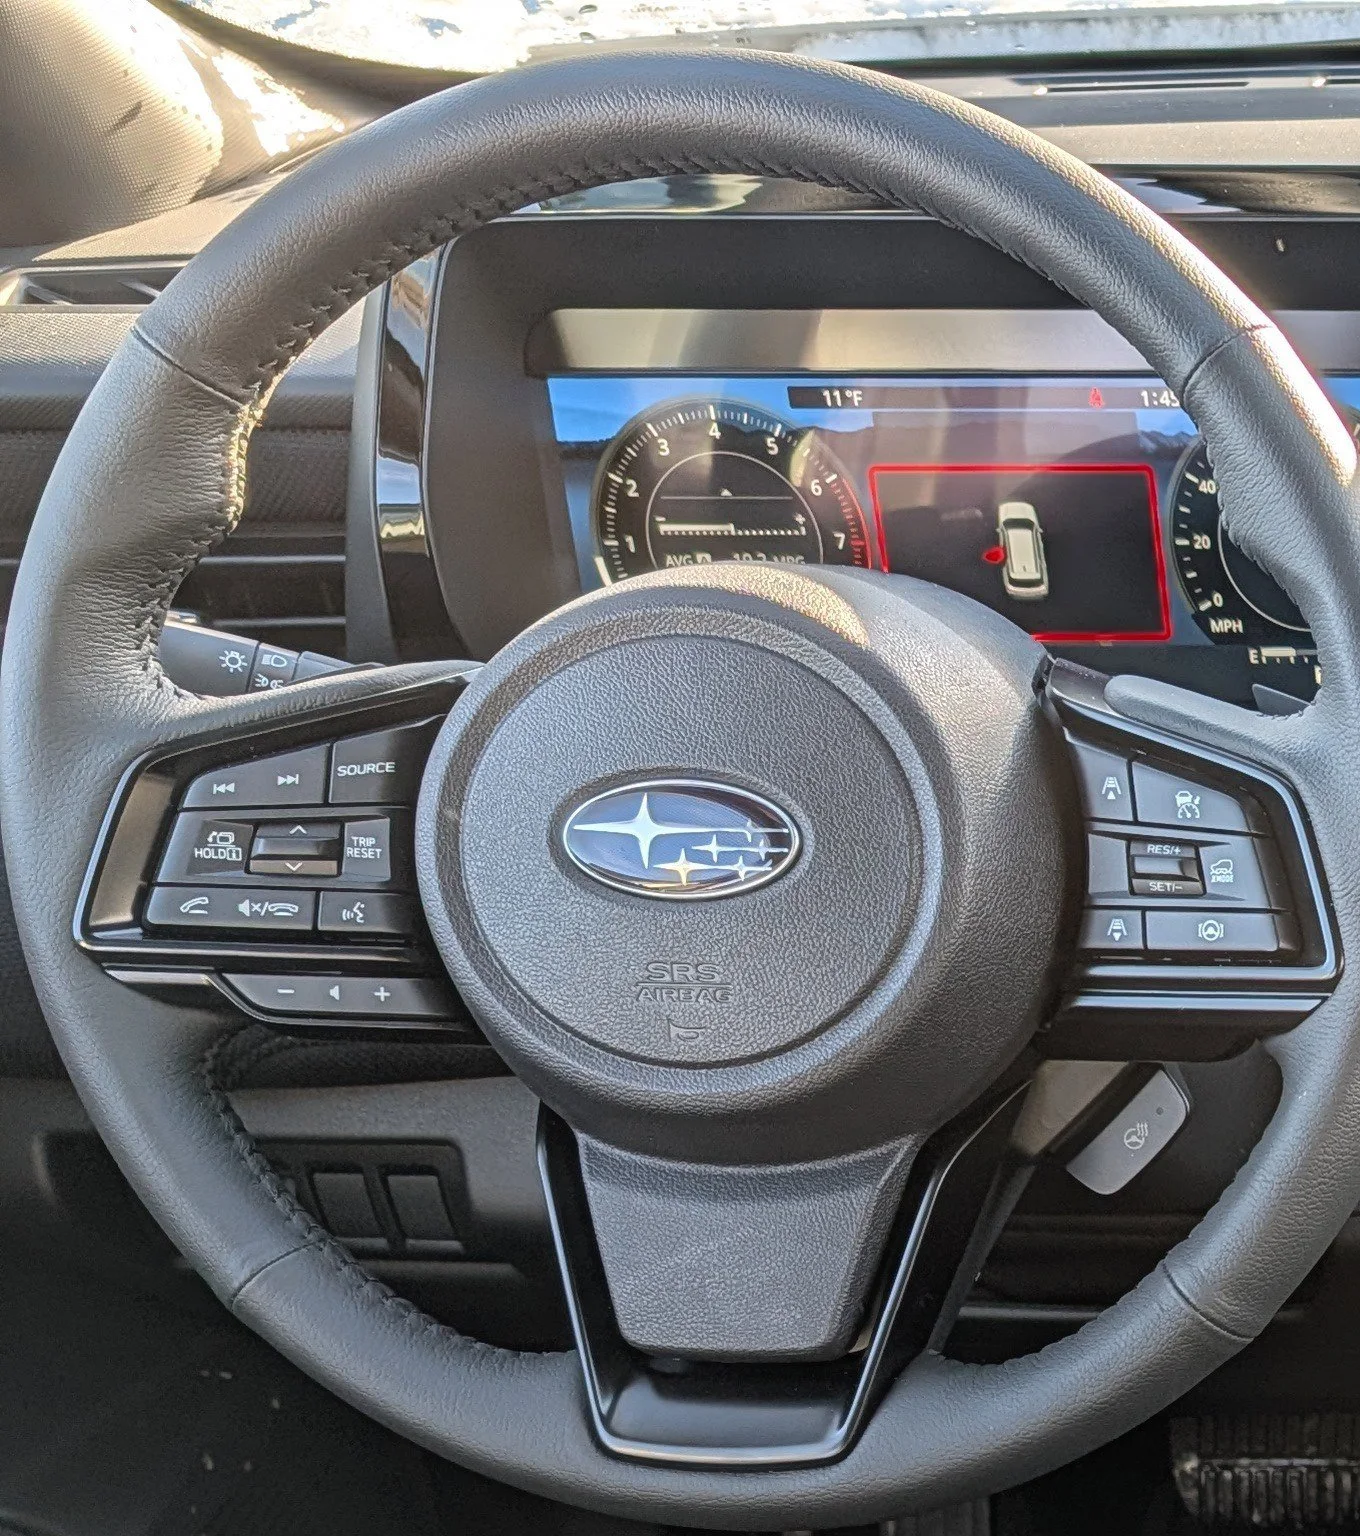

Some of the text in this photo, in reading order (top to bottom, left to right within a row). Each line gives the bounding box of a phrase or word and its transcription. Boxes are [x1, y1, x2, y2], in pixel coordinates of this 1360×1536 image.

[708, 422, 722, 440] 4
[657, 438, 670, 457] 3
[766, 436, 779, 456] 5
[626, 479, 640, 498] 2
[810, 480, 823, 496] 6
[1198, 479, 1217, 495] 40
[625, 534, 636, 554] 1
[833, 532, 846, 550] 7
[1193, 535, 1211, 550] 20
[1212, 593, 1223, 608] 0
[1210, 617, 1244, 633] MPH
[337, 761, 396, 777] SOURCE
[351, 836, 376, 847] TRIP
[194, 847, 226, 860] HOLD
[346, 847, 382, 859] RESET
[647, 962, 723, 982] SRS
[636, 987, 733, 1003] AIRBAG
